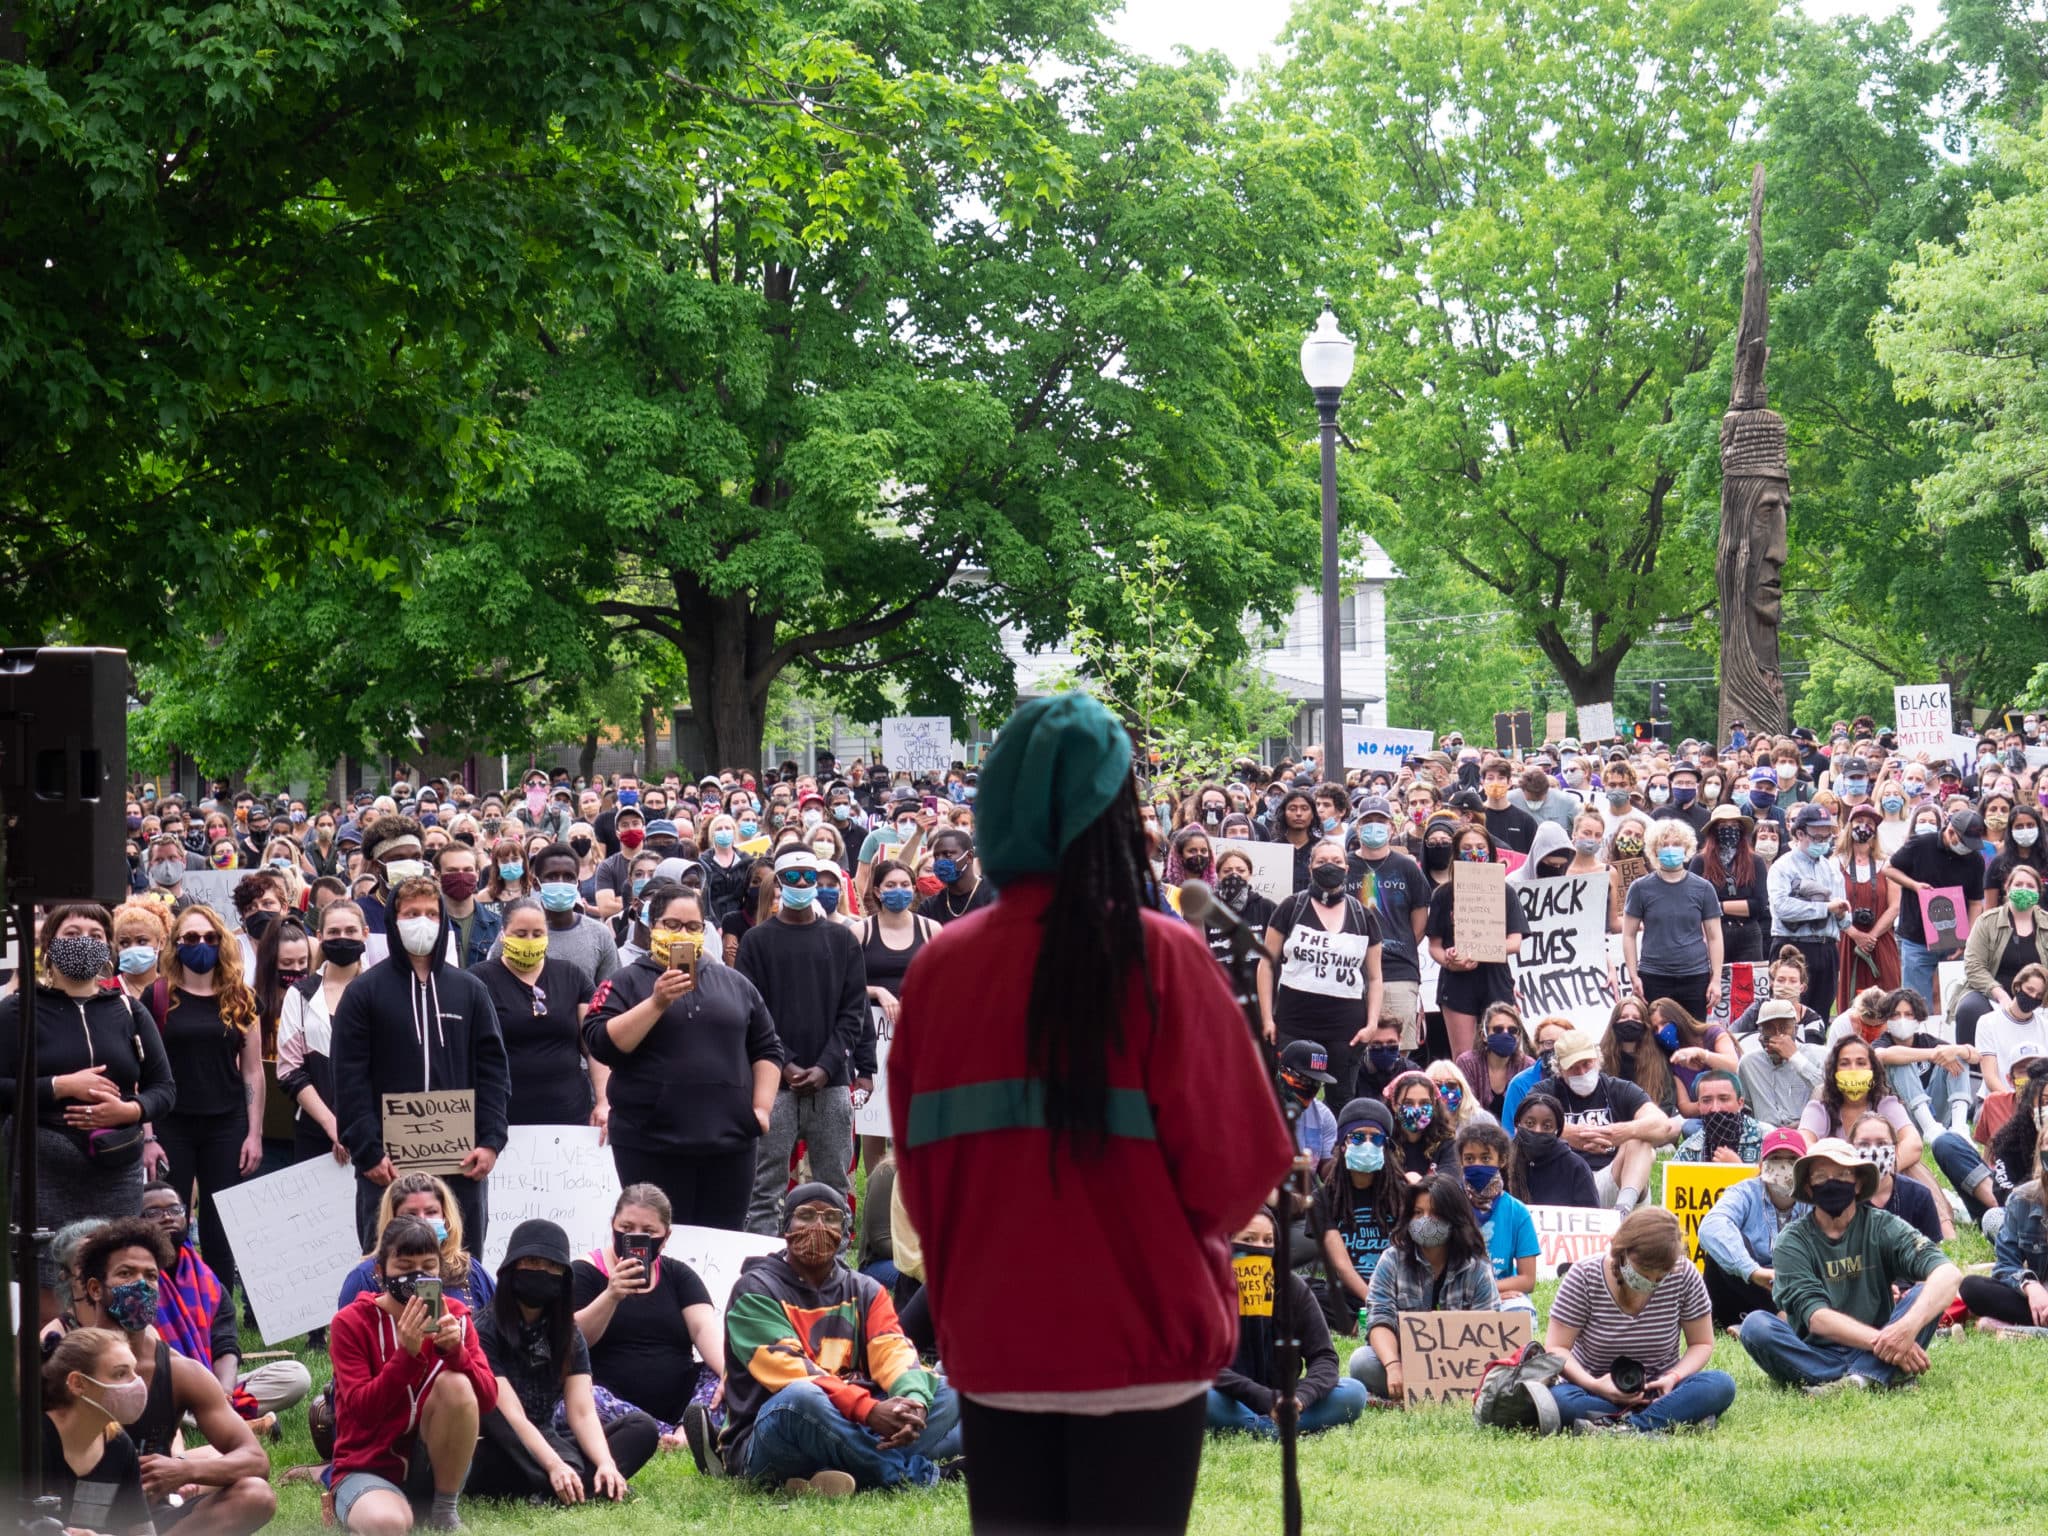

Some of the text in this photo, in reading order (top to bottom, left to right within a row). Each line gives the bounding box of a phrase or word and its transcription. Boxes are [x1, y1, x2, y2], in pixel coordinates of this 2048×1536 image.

[1900, 691, 1948, 711] BLACK
[1900, 710, 1949, 728] LIVES
[1358, 742, 1378, 755] NO
[1900, 730, 1945, 746] MATTER
[1622, 862, 1639, 877] BE
[1378, 880, 1406, 890] LOYD
[1518, 879, 1588, 922] BLACK
[1300, 931, 1329, 948] THE
[1516, 927, 1578, 968] LIVES
[1294, 946, 1361, 969] RESISTANCE
[1315, 966, 1356, 987] IS US
[1518, 965, 1612, 1019] MATTER
[385, 1098, 471, 1118] ENOUGH
[403, 1120, 444, 1134] IS
[385, 1136, 472, 1162] ENOUGH
[246, 1168, 322, 1217] MIGHT
[1675, 1186, 1725, 1210] BLAC
[287, 1203, 331, 1233] THE
[1539, 1210, 1602, 1233] LIFE
[1403, 1317, 1520, 1352] BLACK
